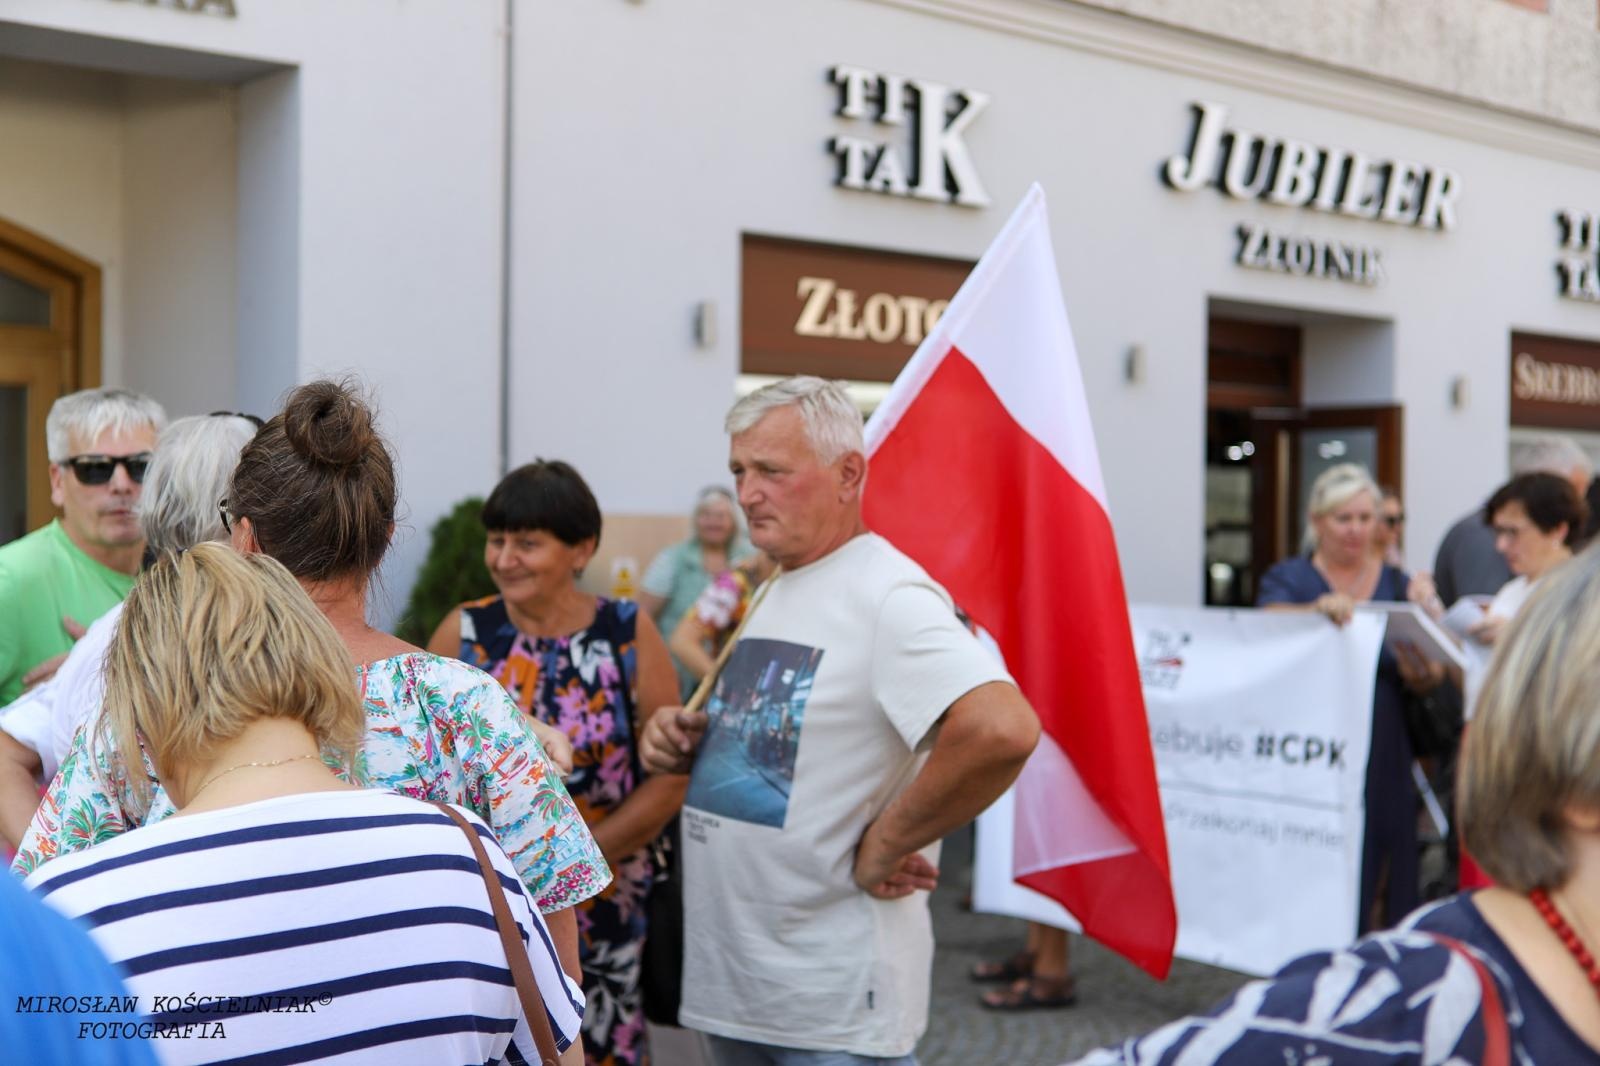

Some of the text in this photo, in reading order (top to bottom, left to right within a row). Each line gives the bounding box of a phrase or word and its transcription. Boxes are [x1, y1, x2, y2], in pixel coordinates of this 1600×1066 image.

[1161, 101, 1460, 230] JUBILER
[1152, 722, 1348, 772] ebuje #CPK
